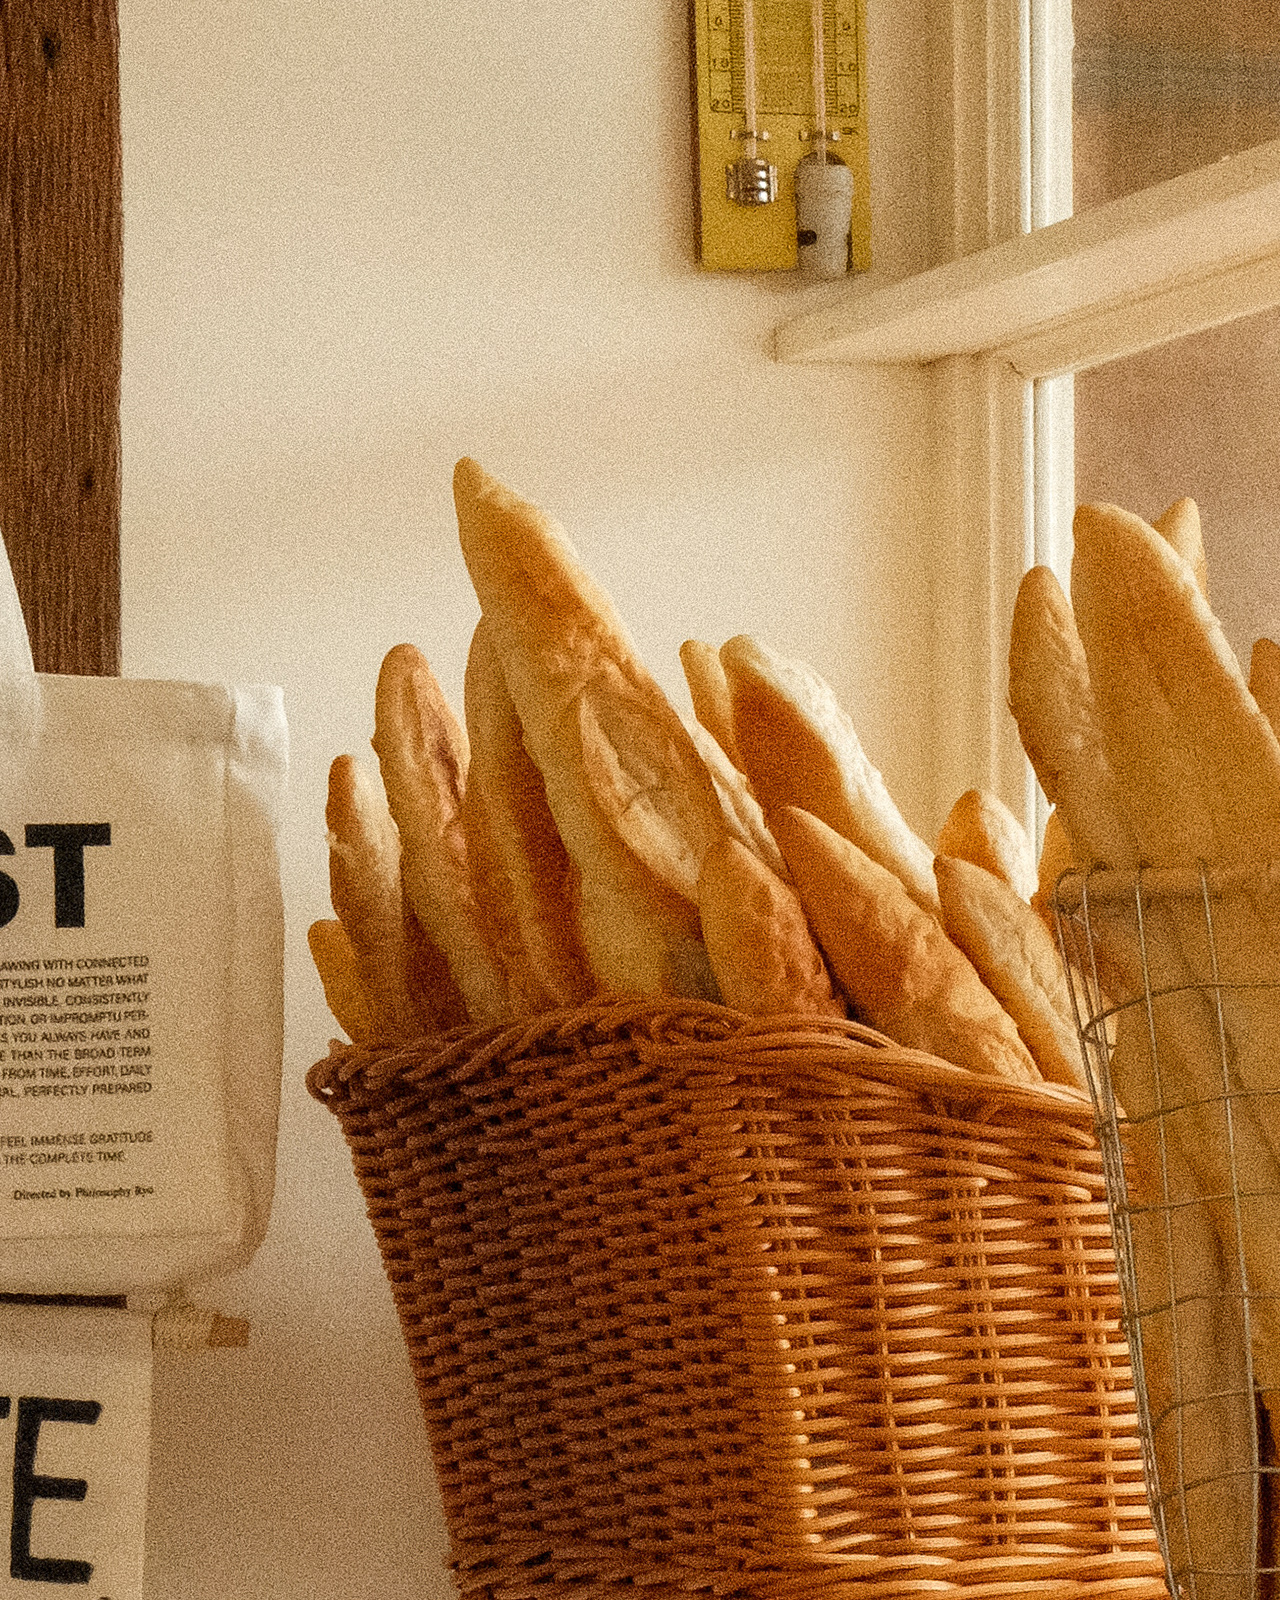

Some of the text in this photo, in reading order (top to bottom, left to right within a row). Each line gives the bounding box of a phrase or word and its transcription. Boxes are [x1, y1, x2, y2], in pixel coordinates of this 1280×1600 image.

[43, 958, 72, 970] WITH
[76, 956, 149, 970] CONNECTED
[47, 976, 64, 988] NO
[68, 975, 113, 988] MATTER
[117, 973, 148, 986] WHAT
[66, 992, 149, 1006] CONSISTENTLY
[41, 1028, 150, 1043] ALWAYS HAVE AND
[11, 1049, 43, 1061] THAN
[48, 1049, 69, 1060] THE
[74, 1047, 114, 1060] BROAD
[119, 1046, 151, 1058] TERM
[2, 1067, 36, 1080] FROM
[23, 1081, 152, 1097] PERFECTLY PREPARED
[0, 1135, 26, 1147] FEEL
[31, 1133, 86, 1146] IMMENSE
[89, 1130, 153, 1144] GRATITUDE
[29, 1152, 93, 1165] COMPLETE
